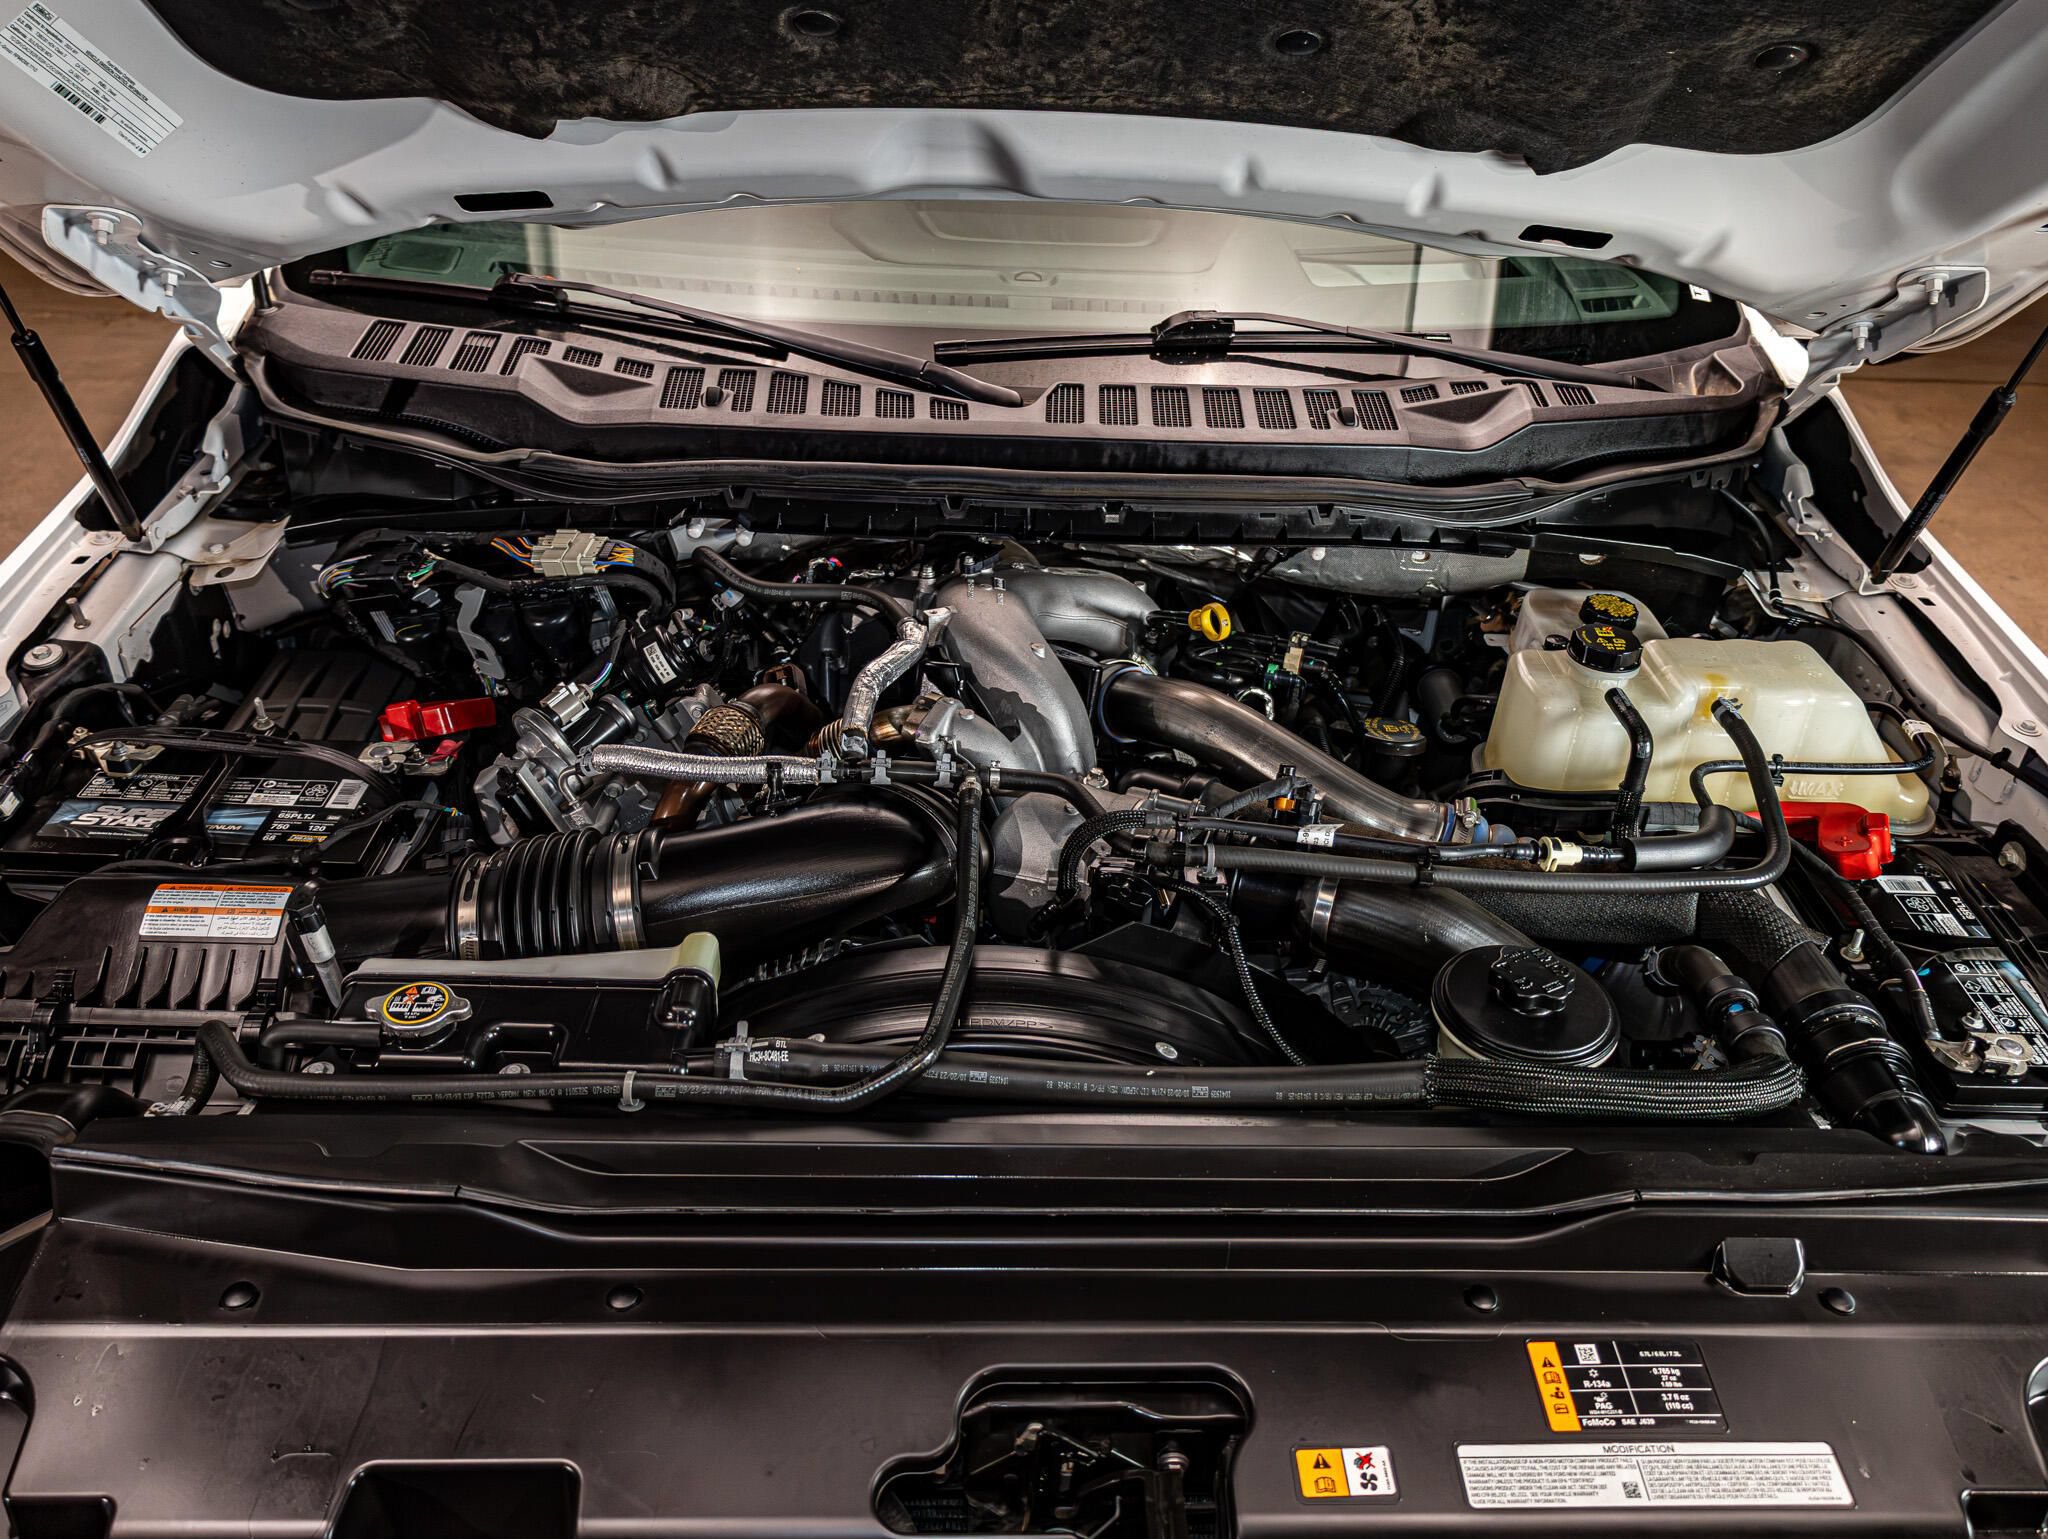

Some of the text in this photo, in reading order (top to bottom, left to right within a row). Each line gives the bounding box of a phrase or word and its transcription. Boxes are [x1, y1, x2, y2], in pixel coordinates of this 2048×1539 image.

[97, 806, 177, 819] SUPE
[1670, 1368, 1681, 1376] kg
[1583, 1380, 1612, 1388] R-134a
[1661, 1393, 1672, 1401] 3.7
[1594, 1402, 1613, 1410] PAG
[1665, 1402, 1694, 1411] (110 cc)
[1582, 1418, 1617, 1426] FoMoCo
[1602, 1445, 1675, 1453] MODIFICATION
